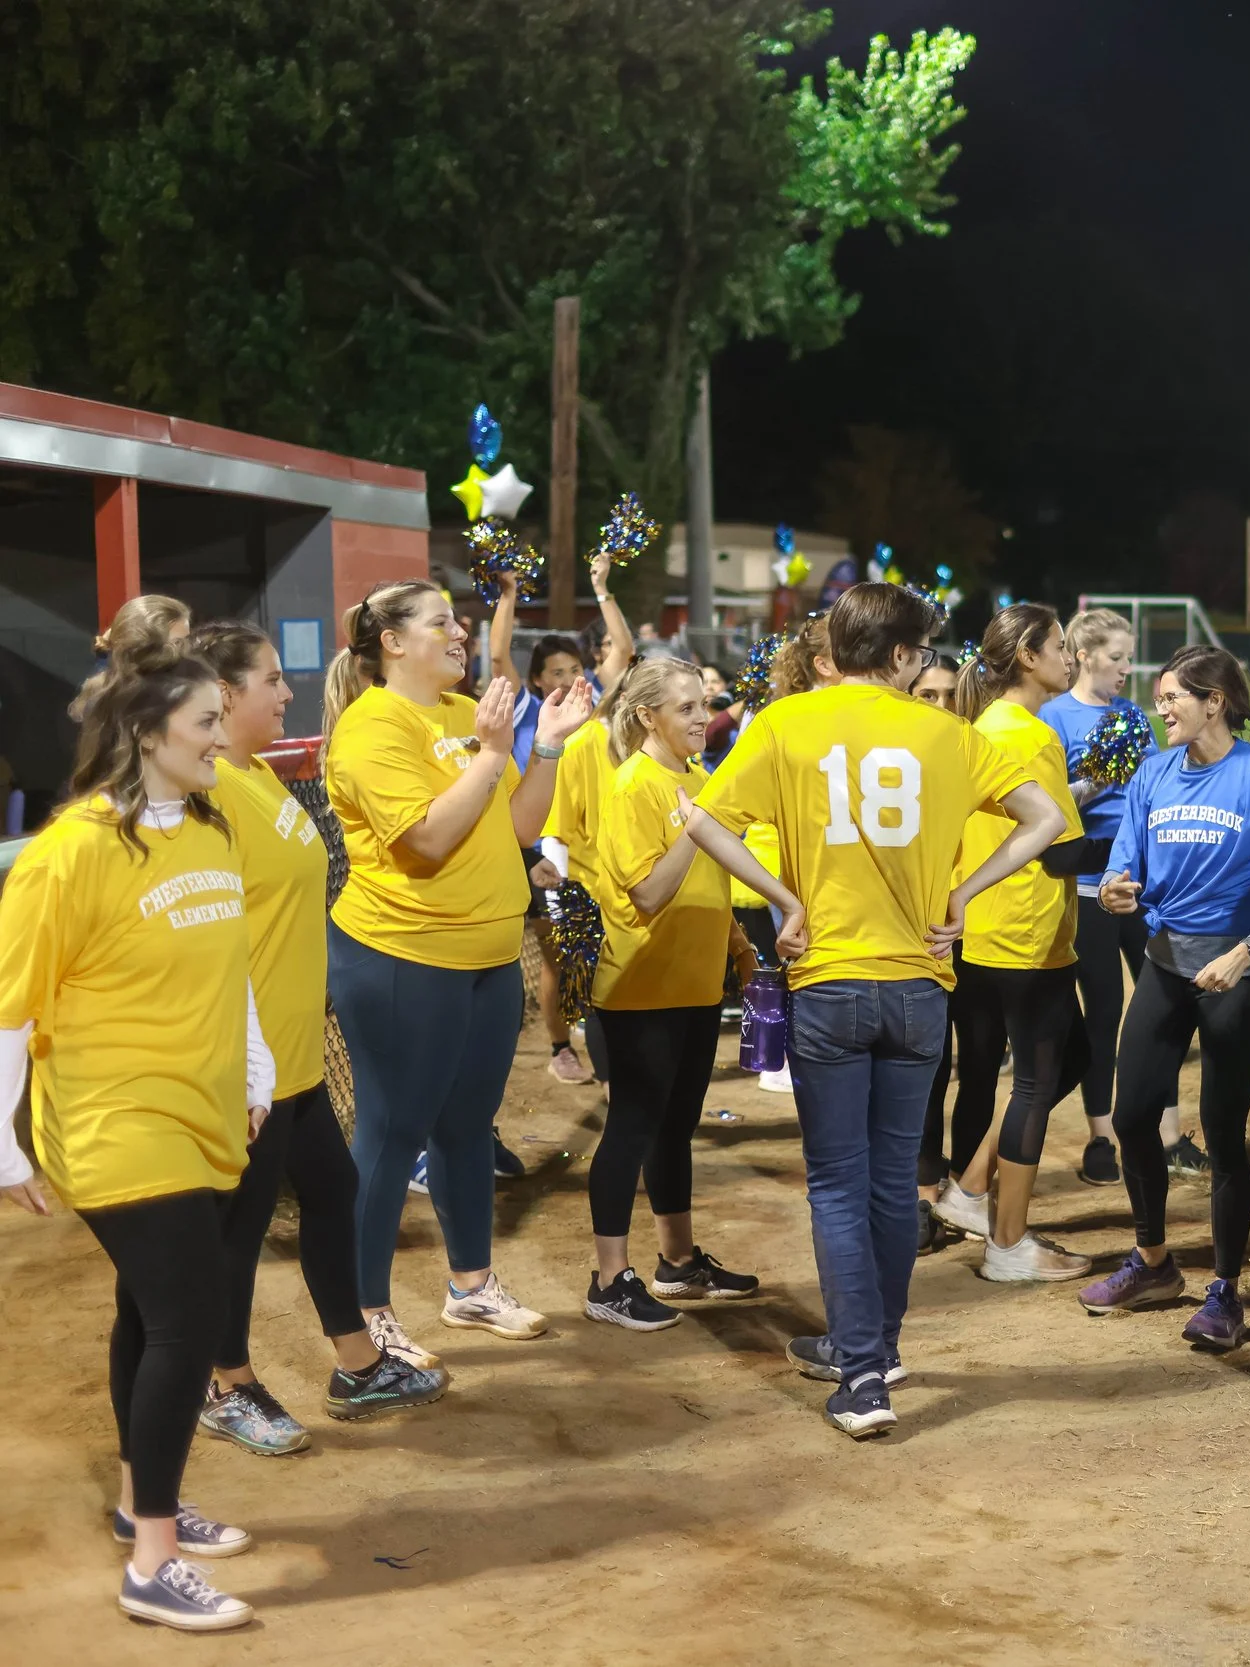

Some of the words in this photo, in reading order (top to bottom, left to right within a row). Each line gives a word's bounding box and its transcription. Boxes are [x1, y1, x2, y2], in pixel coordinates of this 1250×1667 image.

[818, 744, 921, 847] 18
[1148, 805, 1244, 832] CHESTERBROOK
[1157, 829, 1225, 845] ELEMENTARY
